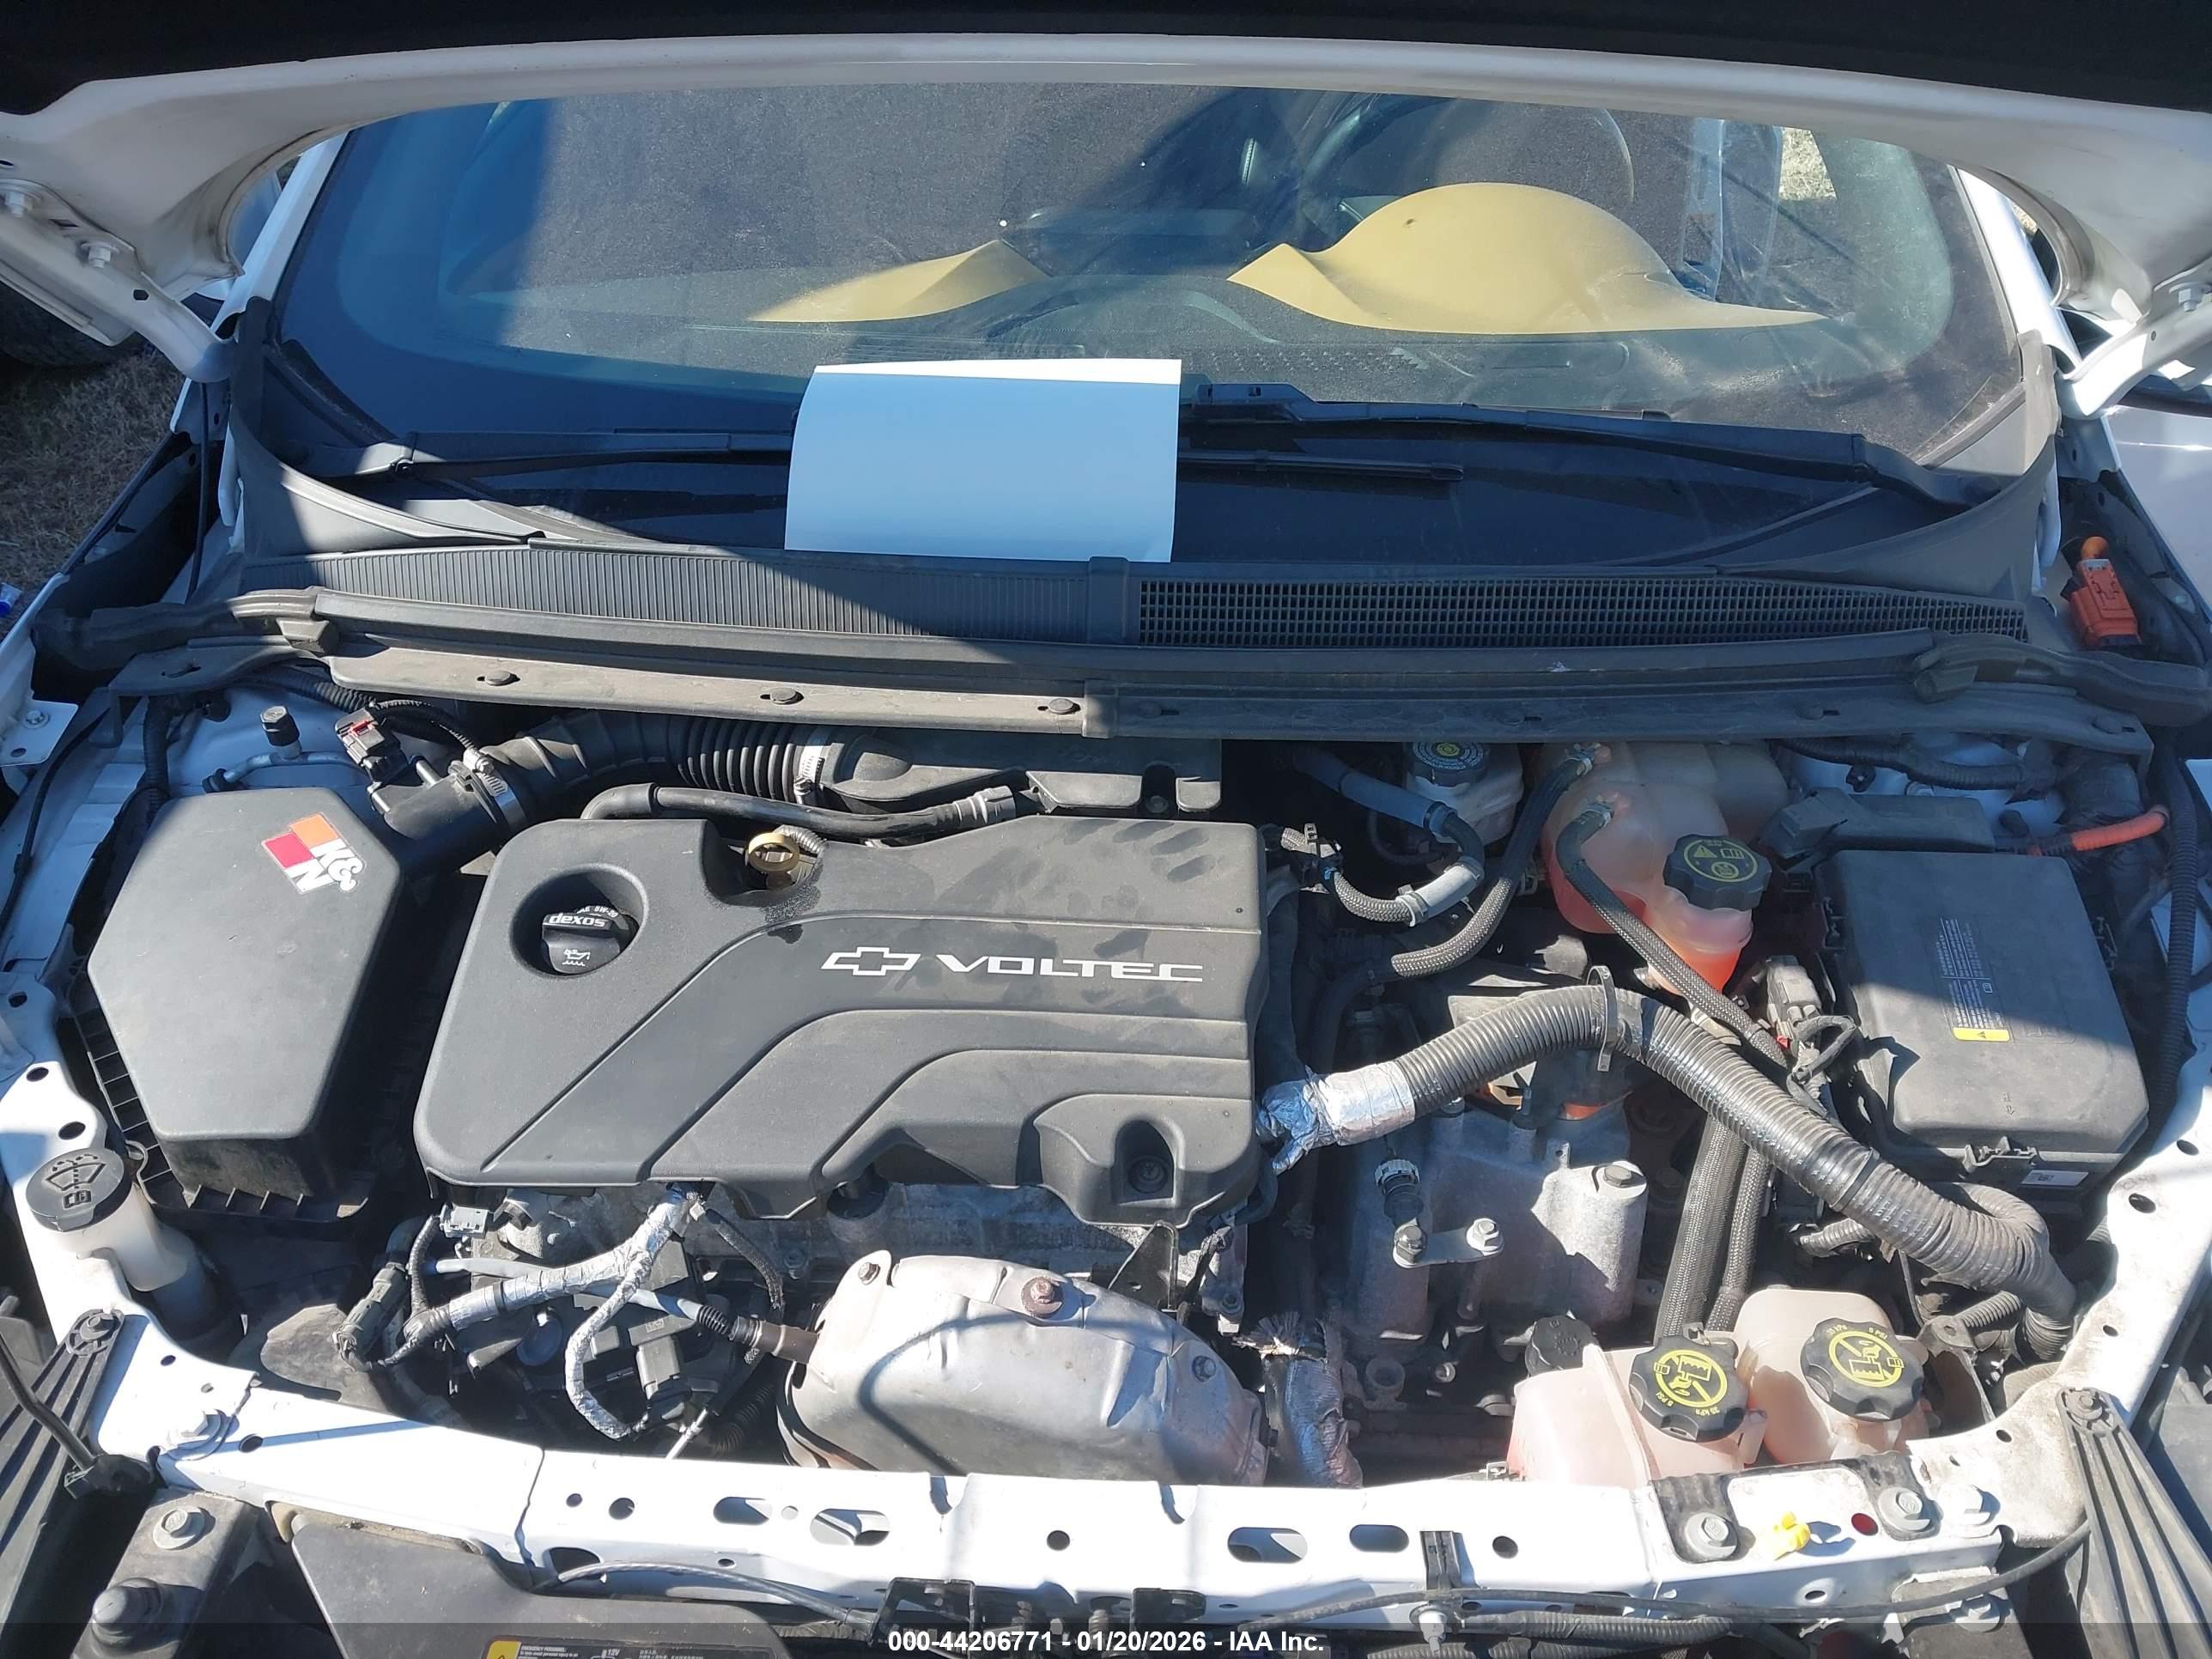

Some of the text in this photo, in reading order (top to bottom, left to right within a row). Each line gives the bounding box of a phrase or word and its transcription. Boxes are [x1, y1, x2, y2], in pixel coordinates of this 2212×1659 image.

[594, 906, 618, 918] 5W-20
[548, 913, 610, 927] dexos
[936, 953, 1203, 982] VOLTEC
